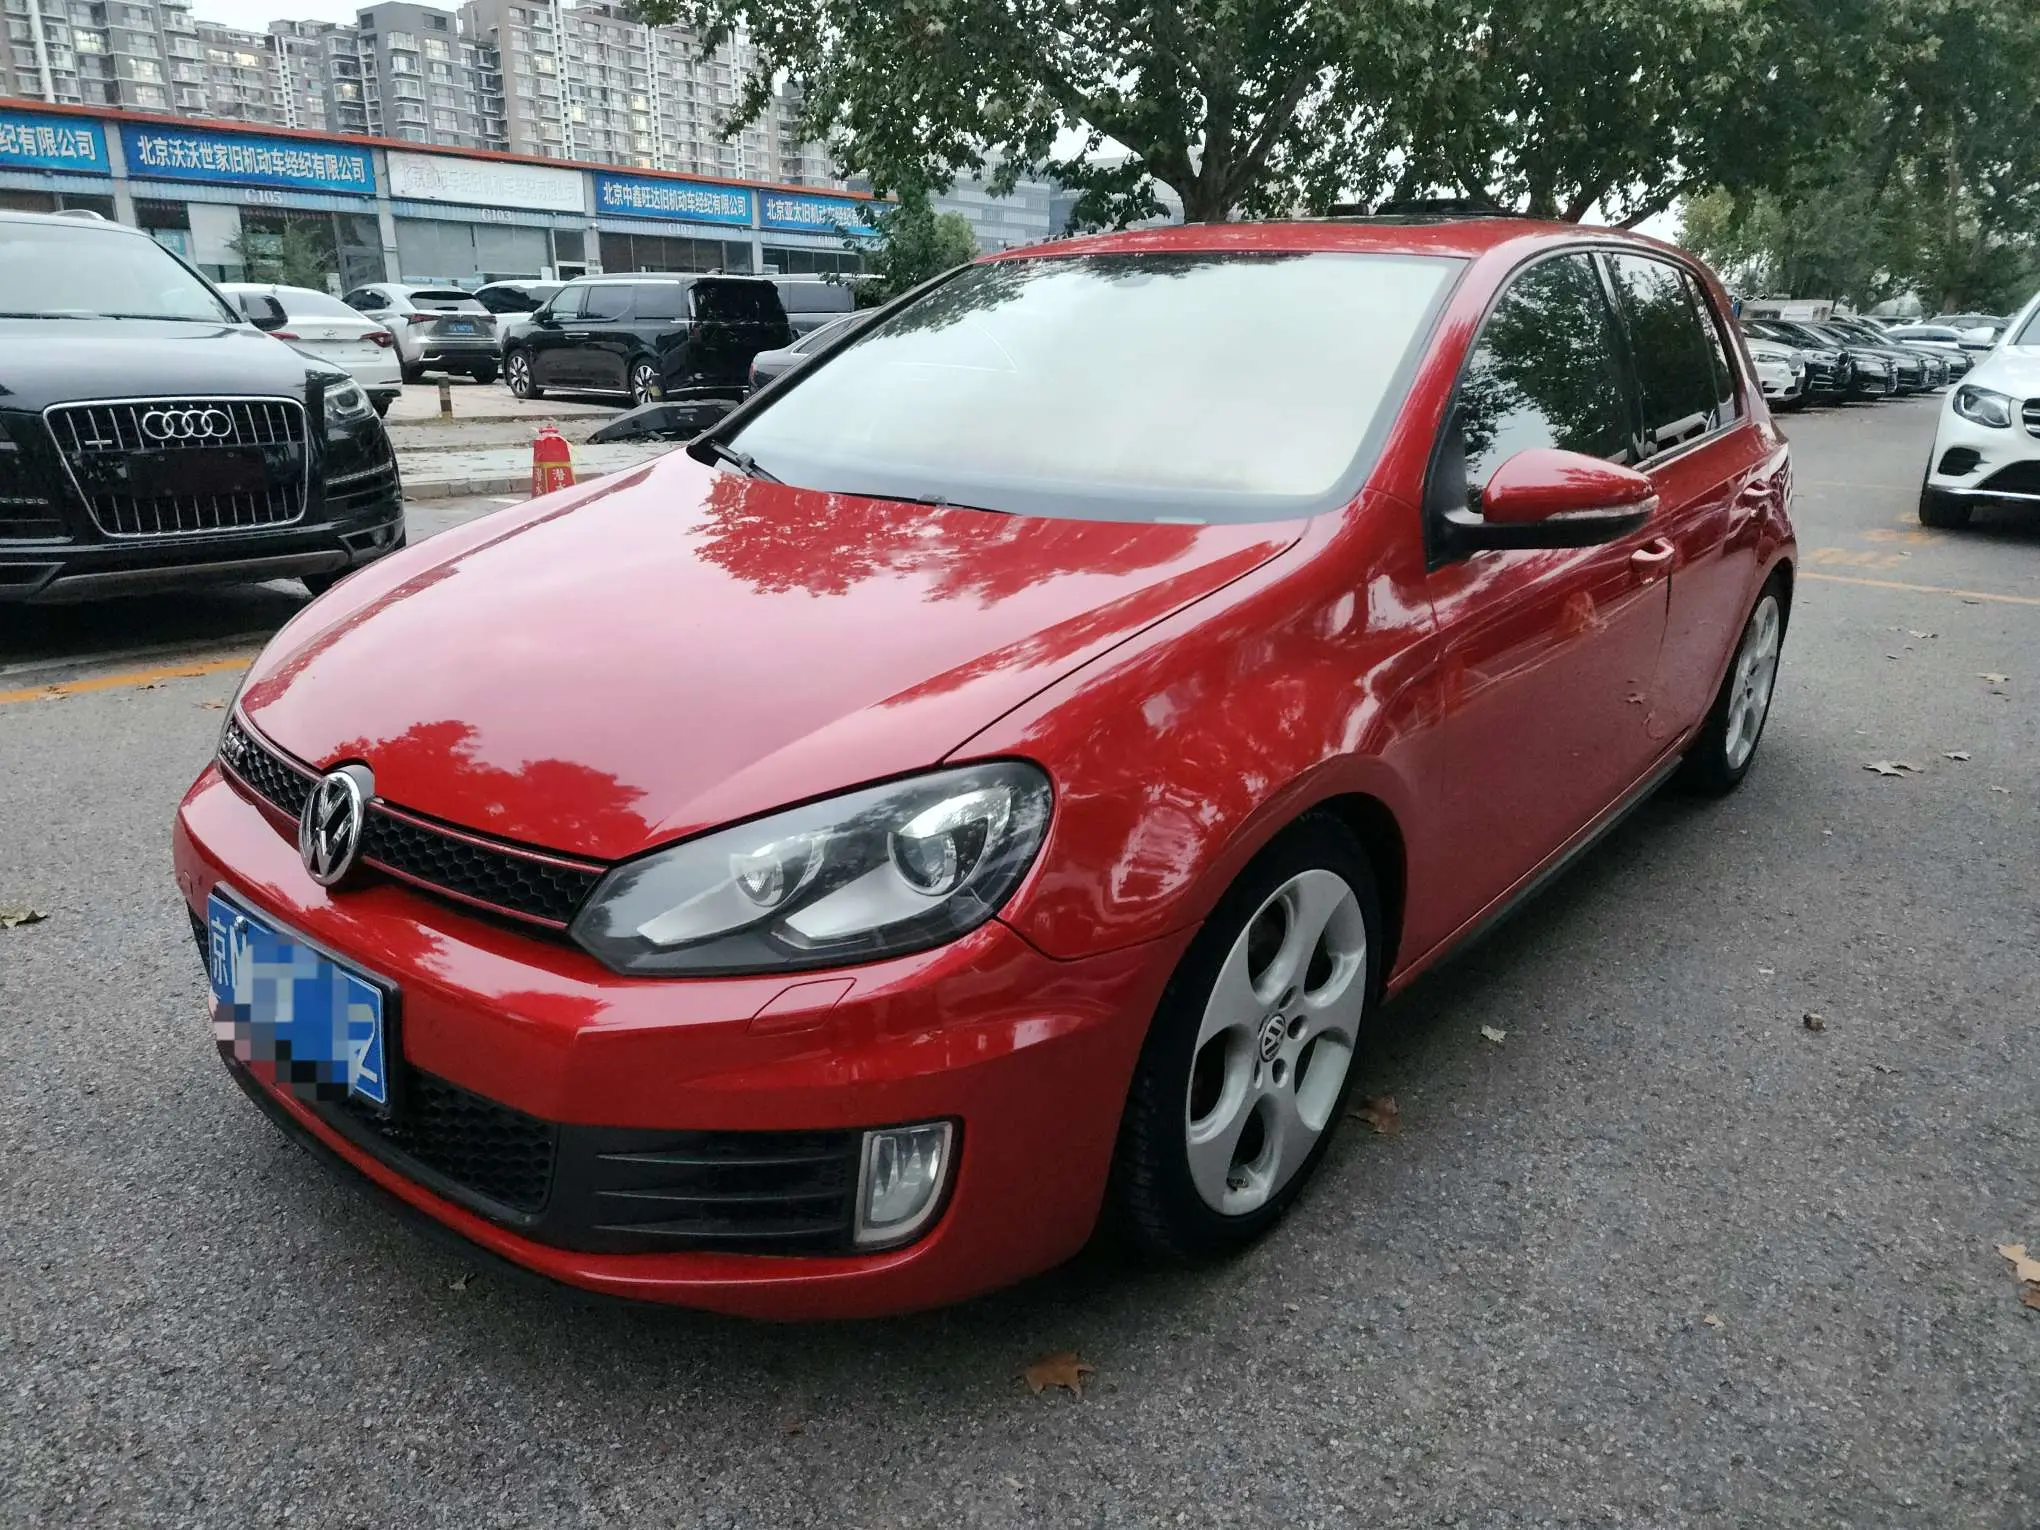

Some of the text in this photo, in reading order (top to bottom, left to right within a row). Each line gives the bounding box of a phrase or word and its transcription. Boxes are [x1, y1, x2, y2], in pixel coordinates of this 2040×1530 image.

[137, 135, 366, 183] 北京沃沃世家旧机动车经纪有限公司
[244, 188, 282, 204] C105
